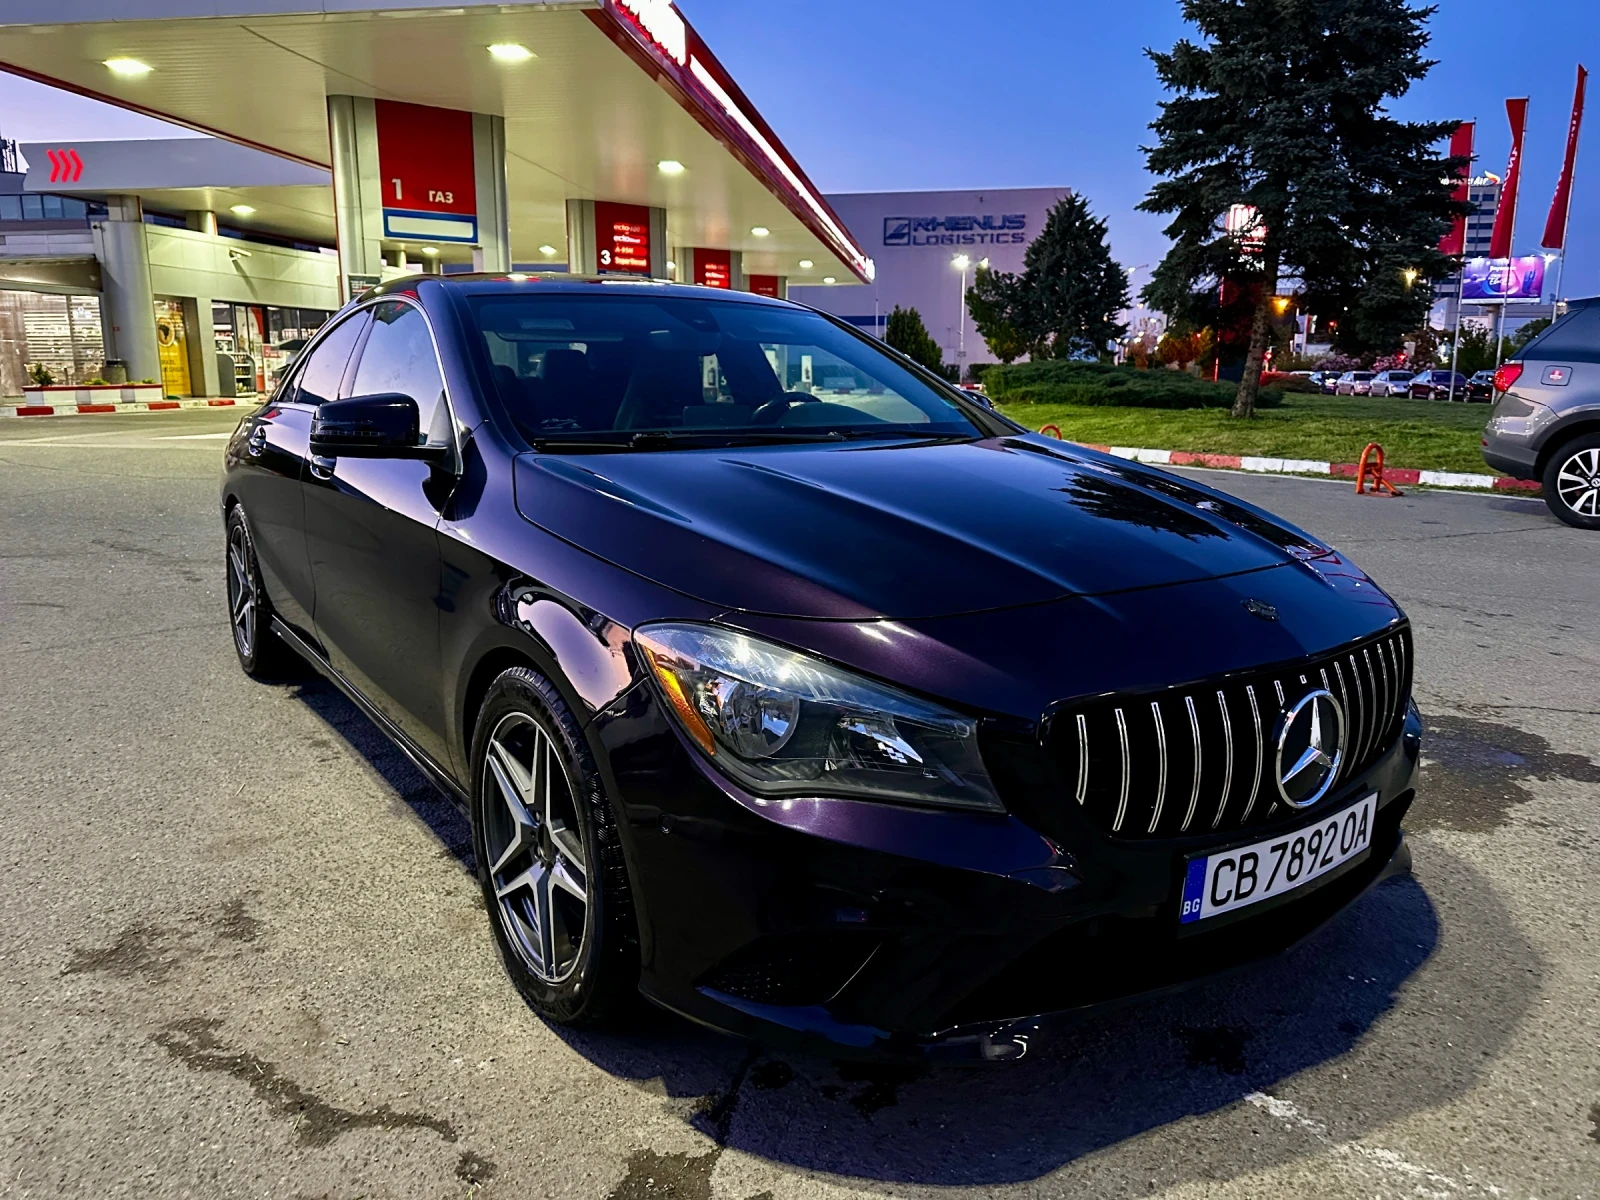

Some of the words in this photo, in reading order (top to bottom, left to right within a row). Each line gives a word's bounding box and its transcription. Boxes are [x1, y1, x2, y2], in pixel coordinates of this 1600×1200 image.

[392, 178, 402, 200] 1
[428, 190, 454, 204] ГАЗ
[912, 214, 1026, 232] RHENUS
[912, 232, 1025, 246] LOGISTICS
[600, 249, 612, 265] 3
[1210, 852, 1259, 907] CB
[1264, 820, 1338, 893] 7892
[1182, 898, 1200, 916] BG
